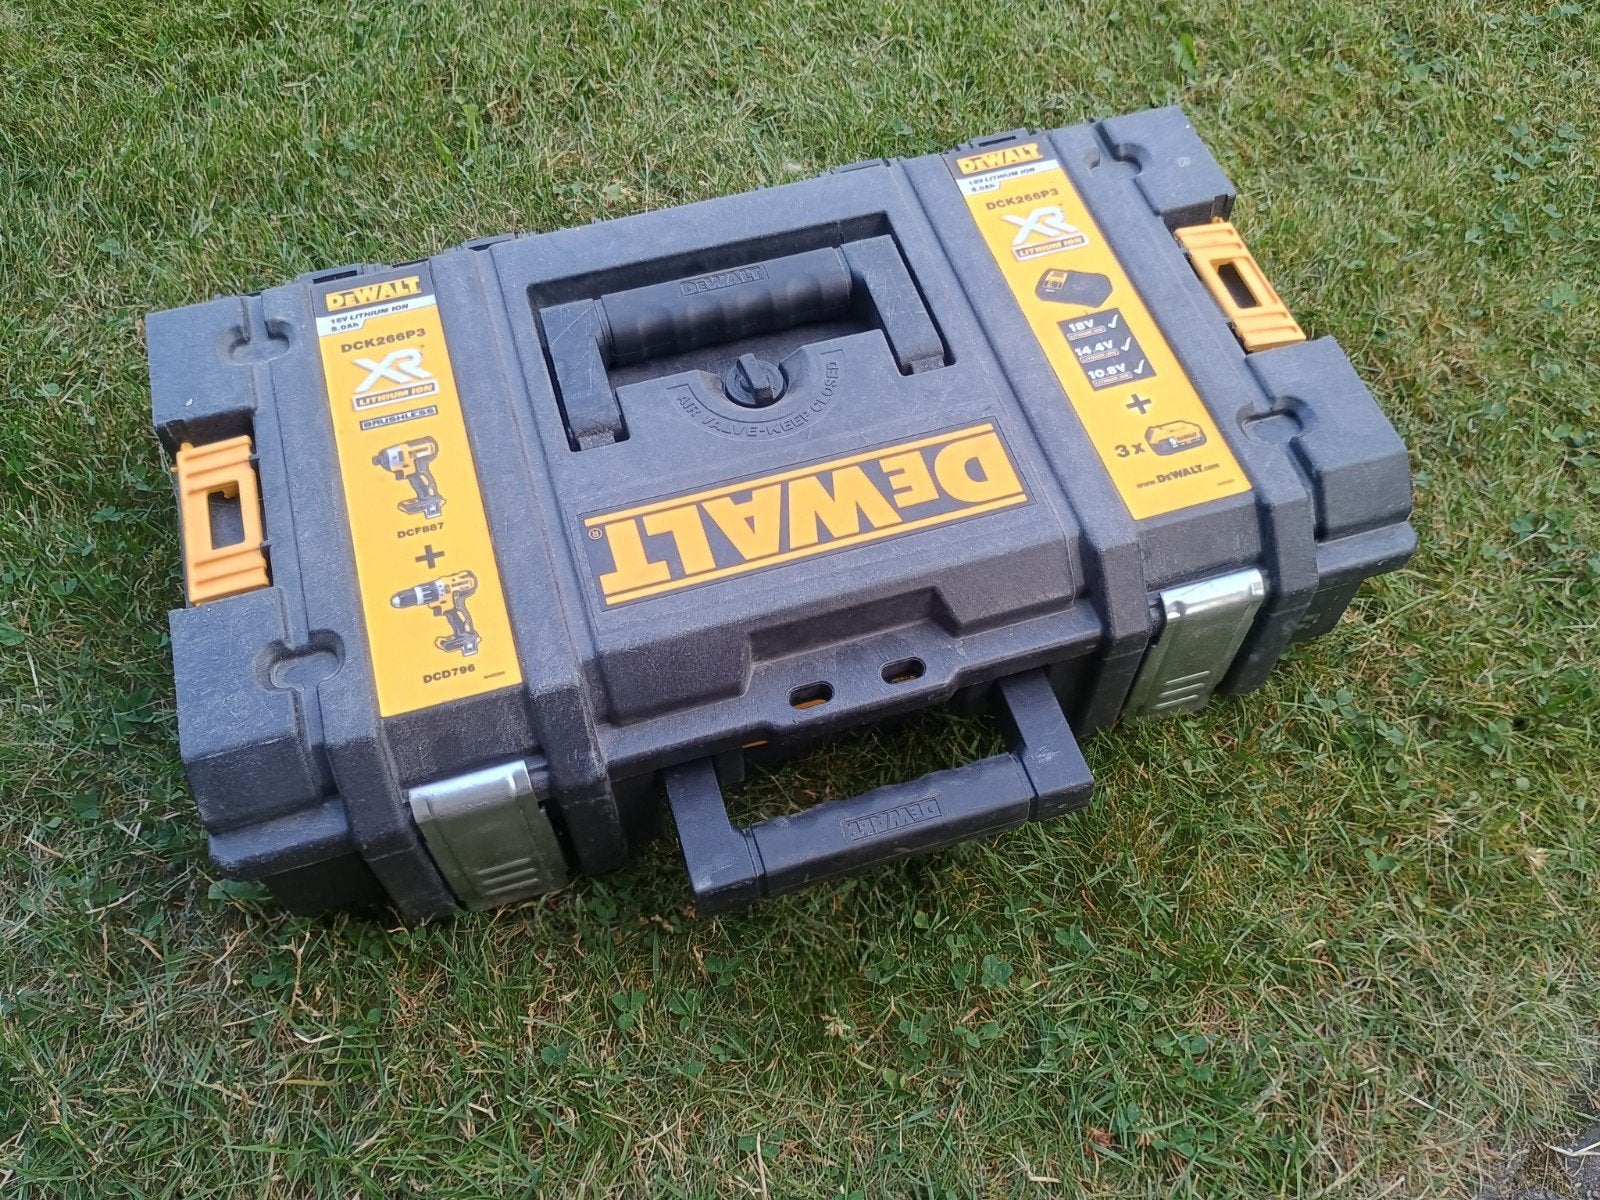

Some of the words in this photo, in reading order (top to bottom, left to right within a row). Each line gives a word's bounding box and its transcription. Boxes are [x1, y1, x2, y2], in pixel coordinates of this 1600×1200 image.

[956, 143, 1044, 176] DEWALT
[984, 171, 1018, 183] LITHIUM
[1020, 167, 1035, 175] ION
[985, 188, 1059, 211] DCK266P3
[1002, 206, 1079, 247] XR
[680, 265, 763, 296] DEWALT
[326, 276, 422, 312] DEWALT
[331, 316, 348, 324] 18V
[350, 307, 389, 321] LITHIUM
[392, 303, 409, 312] ION
[331, 322, 359, 332] 5.0Ah
[1068, 319, 1094, 332] 18V
[341, 328, 426, 353] DCK266P3
[1074, 339, 1113, 357] 14.4V
[352, 349, 433, 394] XR
[1088, 362, 1125, 380] 10.8V
[357, 388, 409, 406] LITHIUM
[409, 384, 434, 396] ION
[677, 396, 701, 418] AIR
[810, 362, 839, 413] CLOSED
[363, 408, 436, 428] BRUSHLESS
[1114, 444, 1130, 458] 3
[397, 522, 445, 539] DCF887
[423, 663, 476, 684] DCD796
[846, 797, 942, 841] DEWALT
